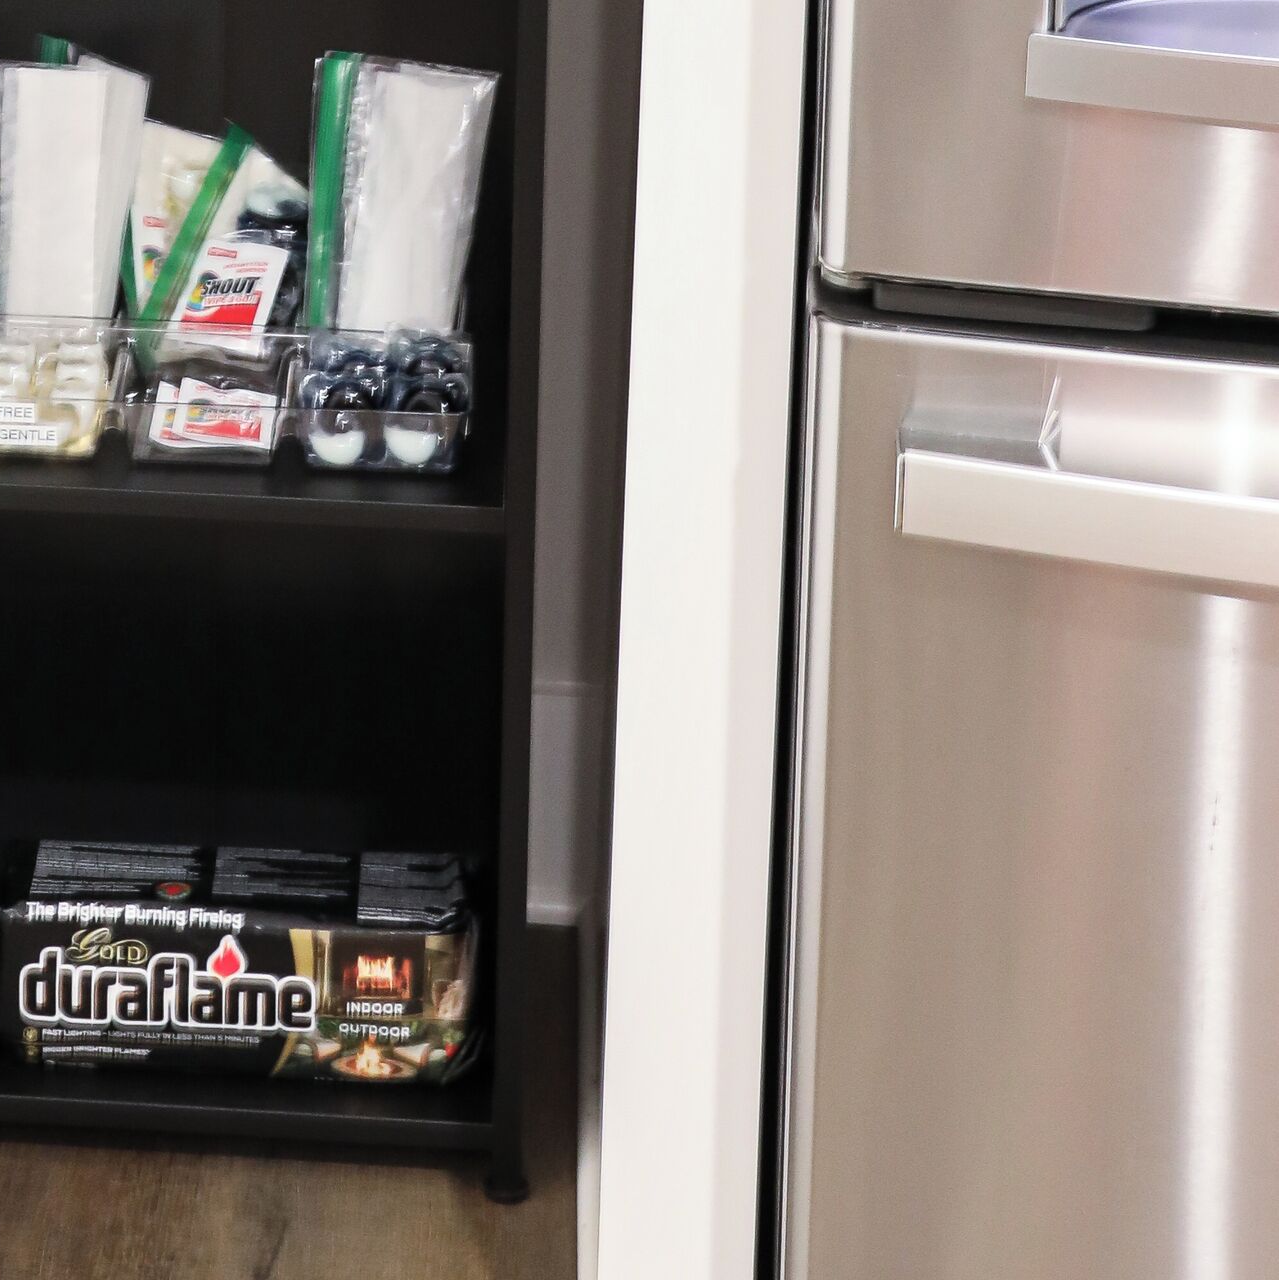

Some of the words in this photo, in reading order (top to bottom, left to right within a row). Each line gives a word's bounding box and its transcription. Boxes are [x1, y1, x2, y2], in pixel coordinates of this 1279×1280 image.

[202, 277, 261, 295] SHOUT
[26, 901, 55, 917] The
[57, 902, 123, 920] Brighter
[125, 904, 187, 924] Burning
[189, 908, 245, 927] Firelog
[19, 946, 319, 1032] duraflame
[346, 1001, 404, 1015] INDOOR
[42, 1028, 61, 1037] FAST
[338, 1022, 412, 1038] OUTDOOR
